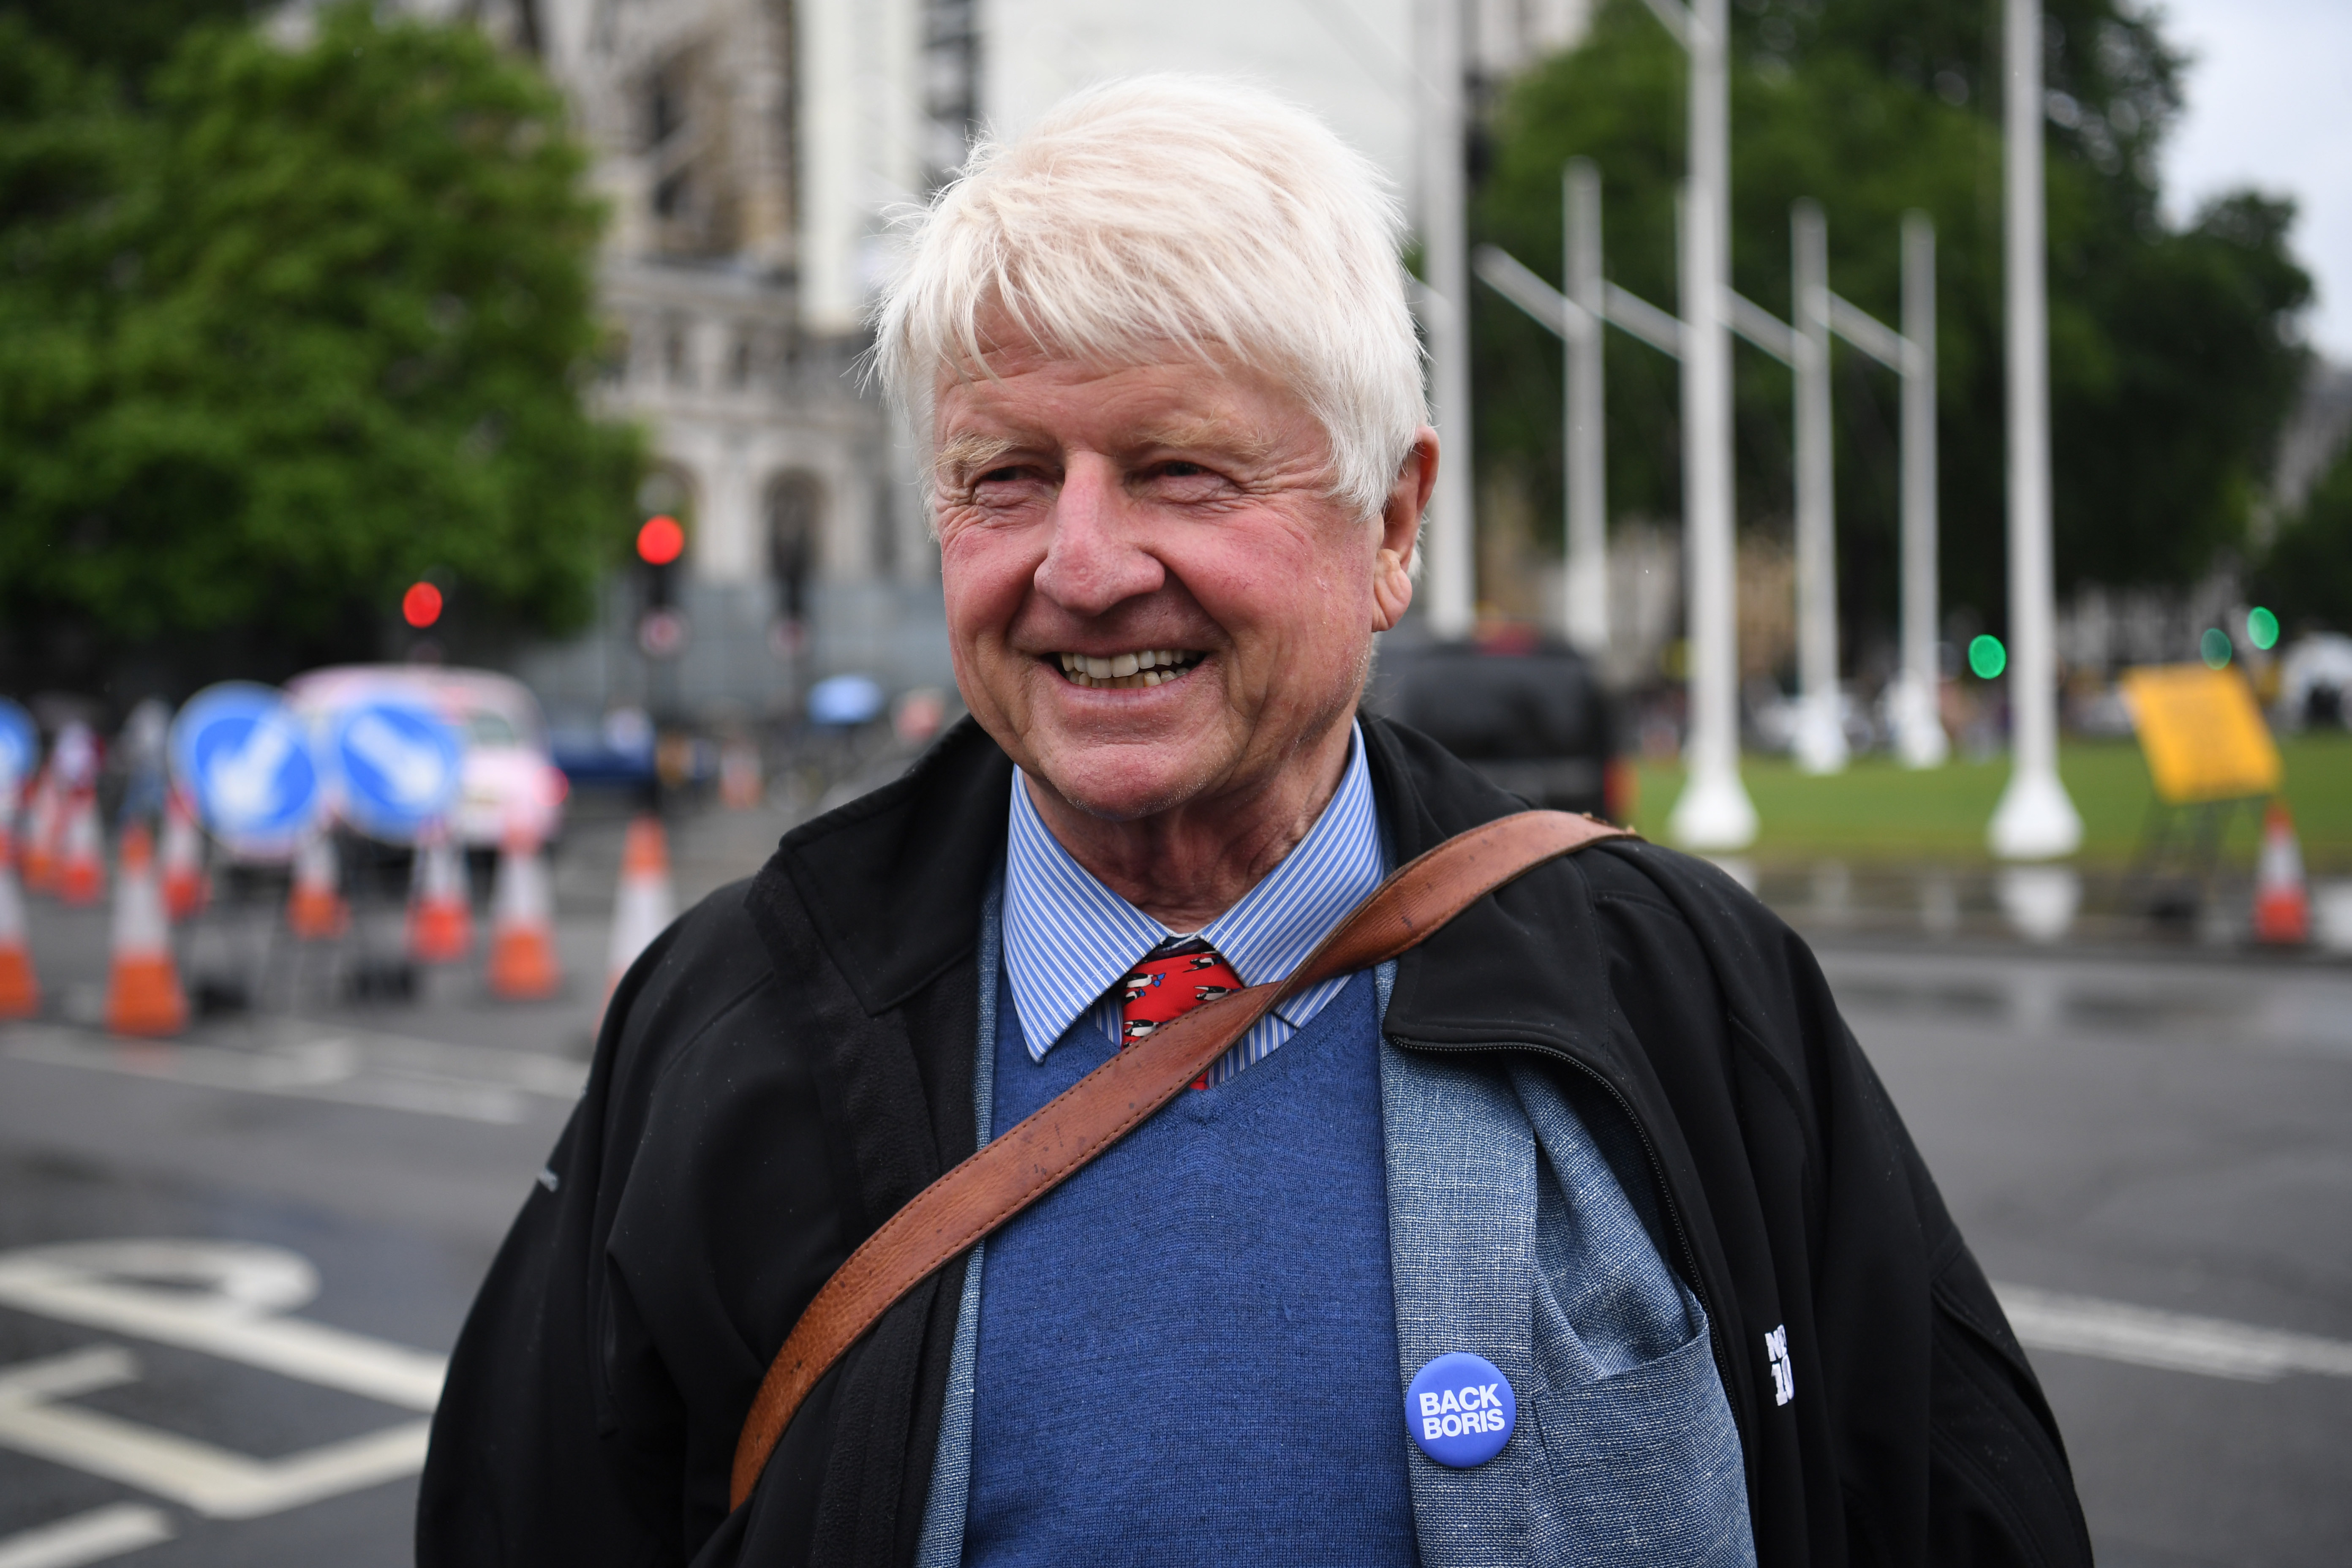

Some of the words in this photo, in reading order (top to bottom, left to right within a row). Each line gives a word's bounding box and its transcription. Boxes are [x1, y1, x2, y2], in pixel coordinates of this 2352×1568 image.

[1771, 1353, 1794, 1406] 10
[1419, 1383, 1503, 1416] BACK
[1422, 1408, 1505, 1440] BORIS
